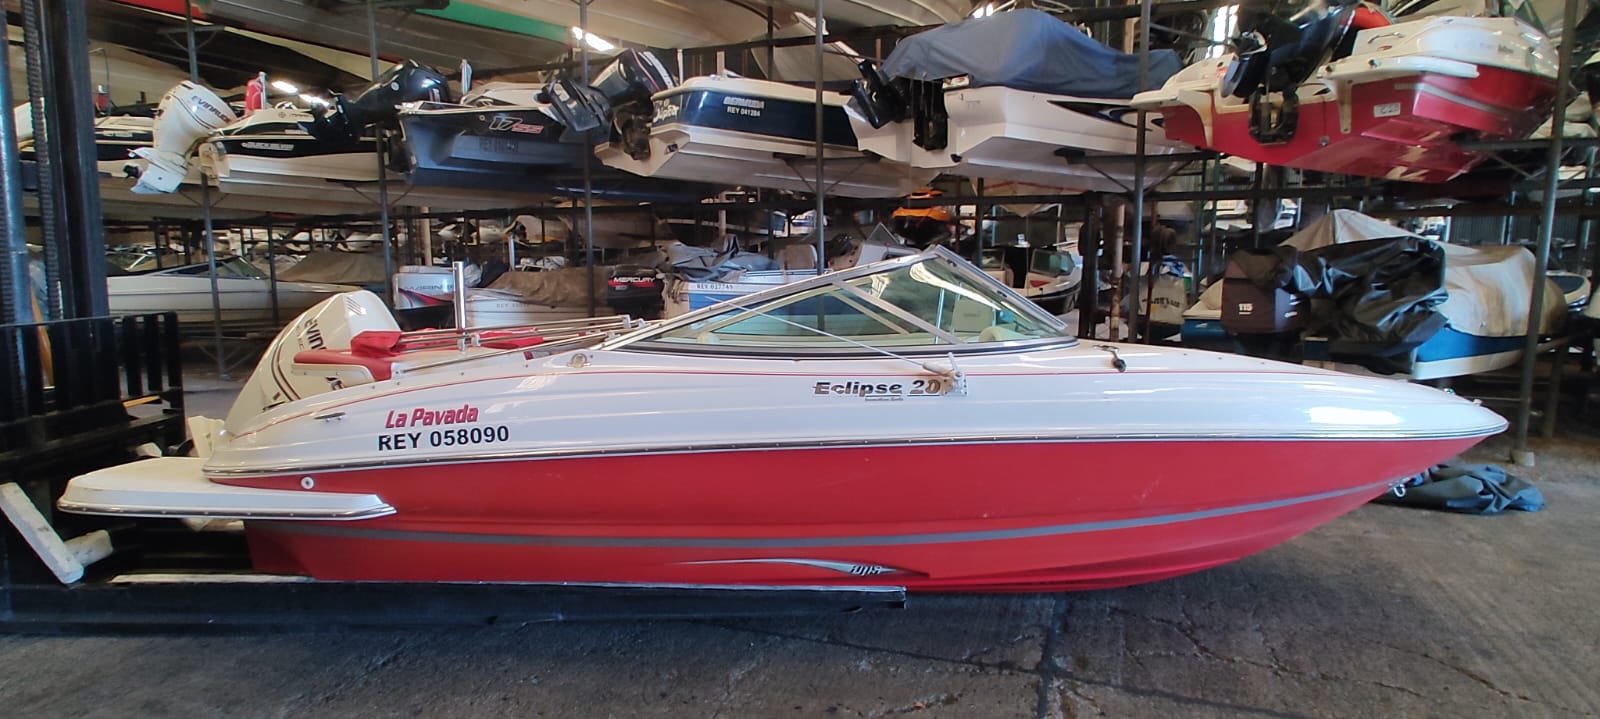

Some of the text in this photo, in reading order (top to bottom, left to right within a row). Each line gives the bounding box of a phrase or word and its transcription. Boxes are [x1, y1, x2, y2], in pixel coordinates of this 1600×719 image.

[727, 106, 740, 115] REY
[1238, 303, 1253, 312] 115
[814, 381, 902, 397] Eclipse
[385, 404, 479, 428] La Pavada
[378, 425, 509, 451] REY 058090
